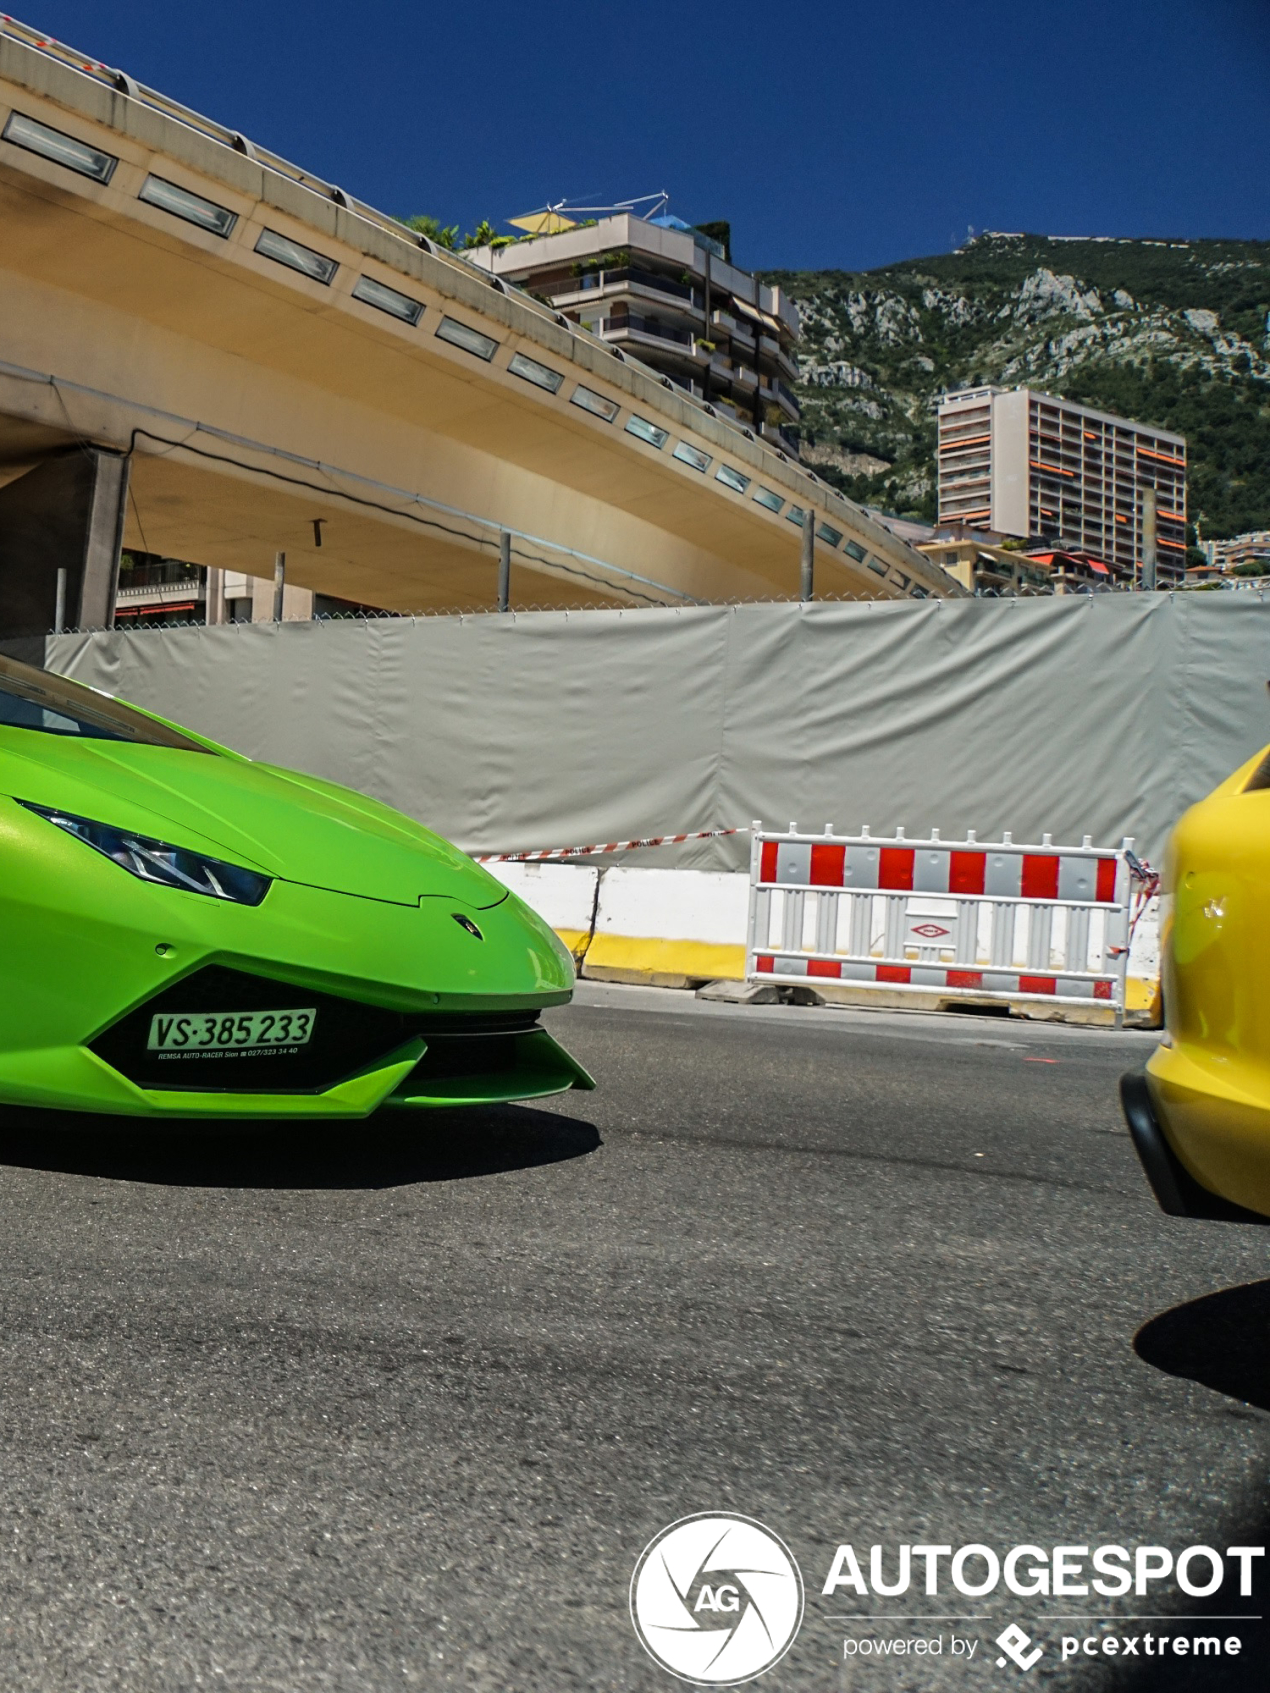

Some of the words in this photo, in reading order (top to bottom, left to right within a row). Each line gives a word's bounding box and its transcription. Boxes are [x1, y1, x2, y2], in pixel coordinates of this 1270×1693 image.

[565, 846, 591, 856] POLICE
[631, 839, 660, 848] POLICE
[256, 1014, 311, 1044] 233
[248, 1048, 277, 1057] 027/323
